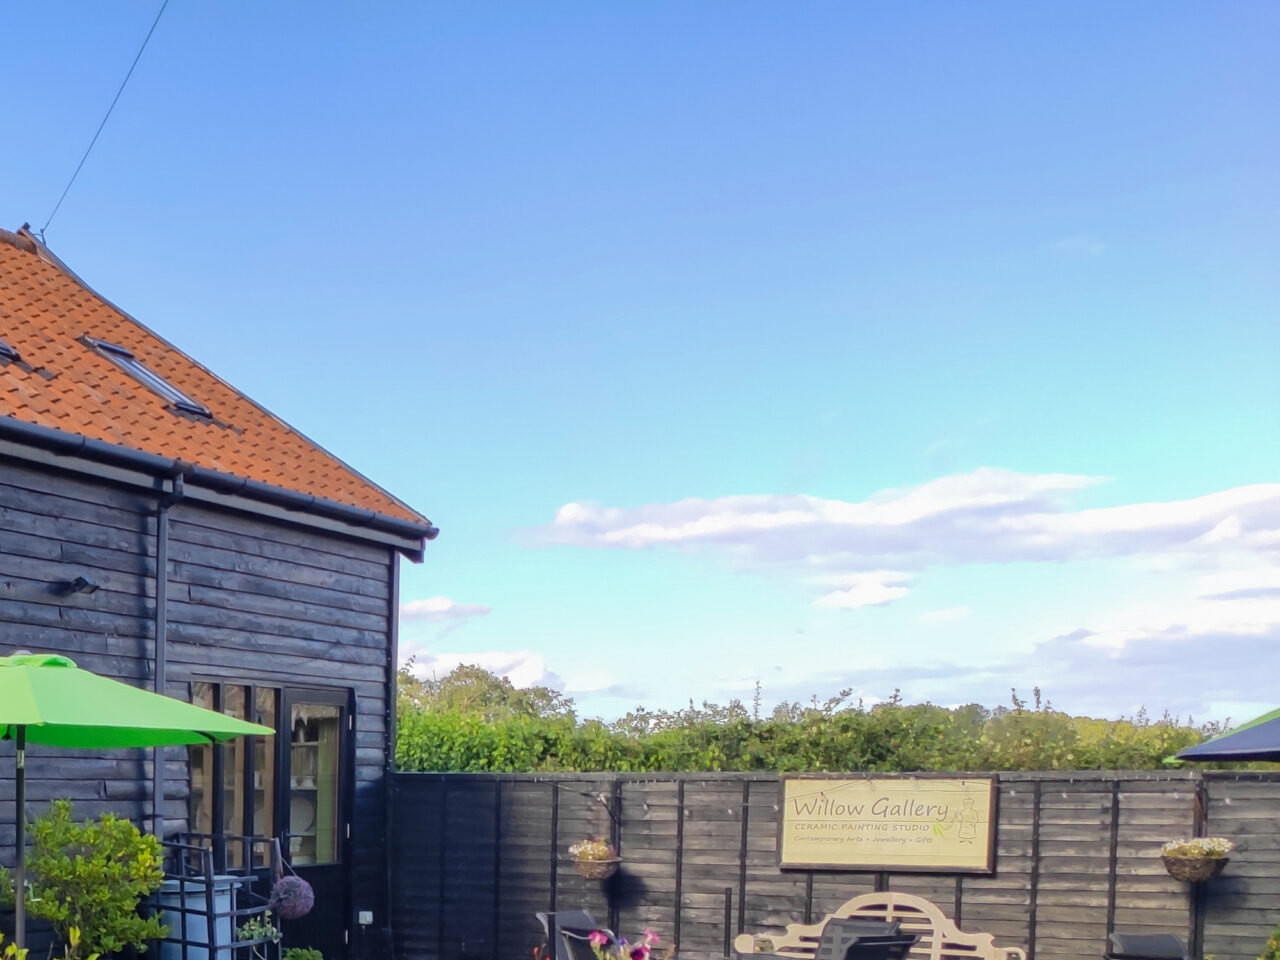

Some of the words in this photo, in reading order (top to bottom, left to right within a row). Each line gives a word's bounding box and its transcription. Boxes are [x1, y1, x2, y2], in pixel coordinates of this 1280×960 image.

[793, 797, 865, 816] Willow
[871, 797, 949, 822] Gallery
[794, 823, 838, 832] CERAMIC
[841, 823, 888, 832] PAINTING
[892, 823, 930, 832] STUDIO
